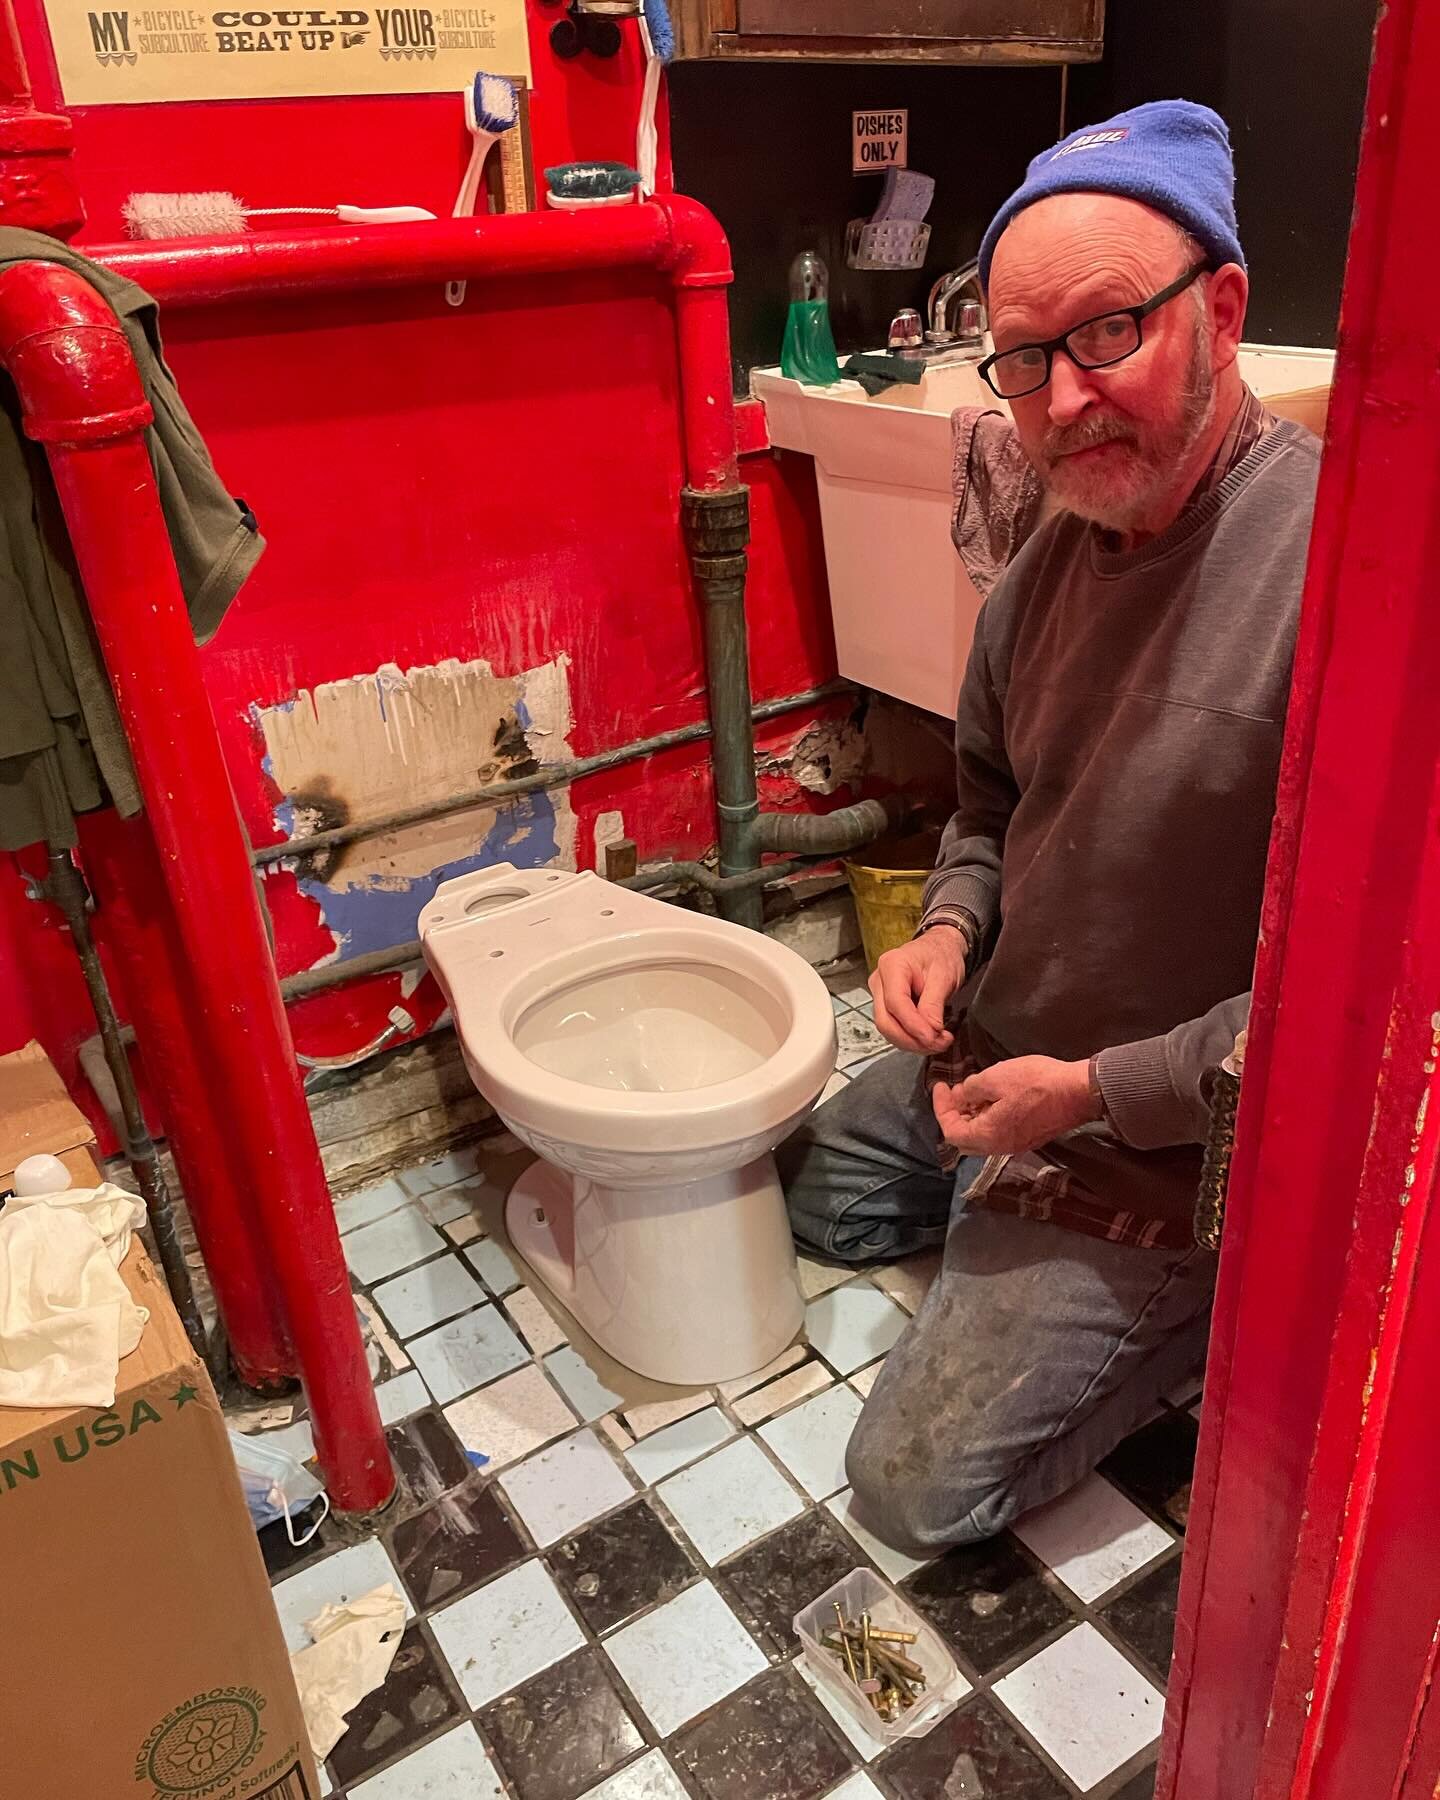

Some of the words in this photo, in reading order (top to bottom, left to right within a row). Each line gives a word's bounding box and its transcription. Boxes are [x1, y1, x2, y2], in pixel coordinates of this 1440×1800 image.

[142, 10, 198, 31] BICYCLE
[212, 11, 369, 27] COULD
[375, 8, 436, 47] YOUR
[443, 9, 489, 28] BICYCLE
[87, 11, 131, 52] MY
[215, 31, 293, 52] BEAT
[298, 30, 335, 51] UP
[438, 30, 496, 49] SUBCULTURE
[138, 33, 210, 54] SUBCULTURE
[856, 115, 903, 136] DISHES
[861, 141, 899, 162] ONLY
[0, 1449, 40, 1494] N
[53, 1399, 162, 1463] USA
